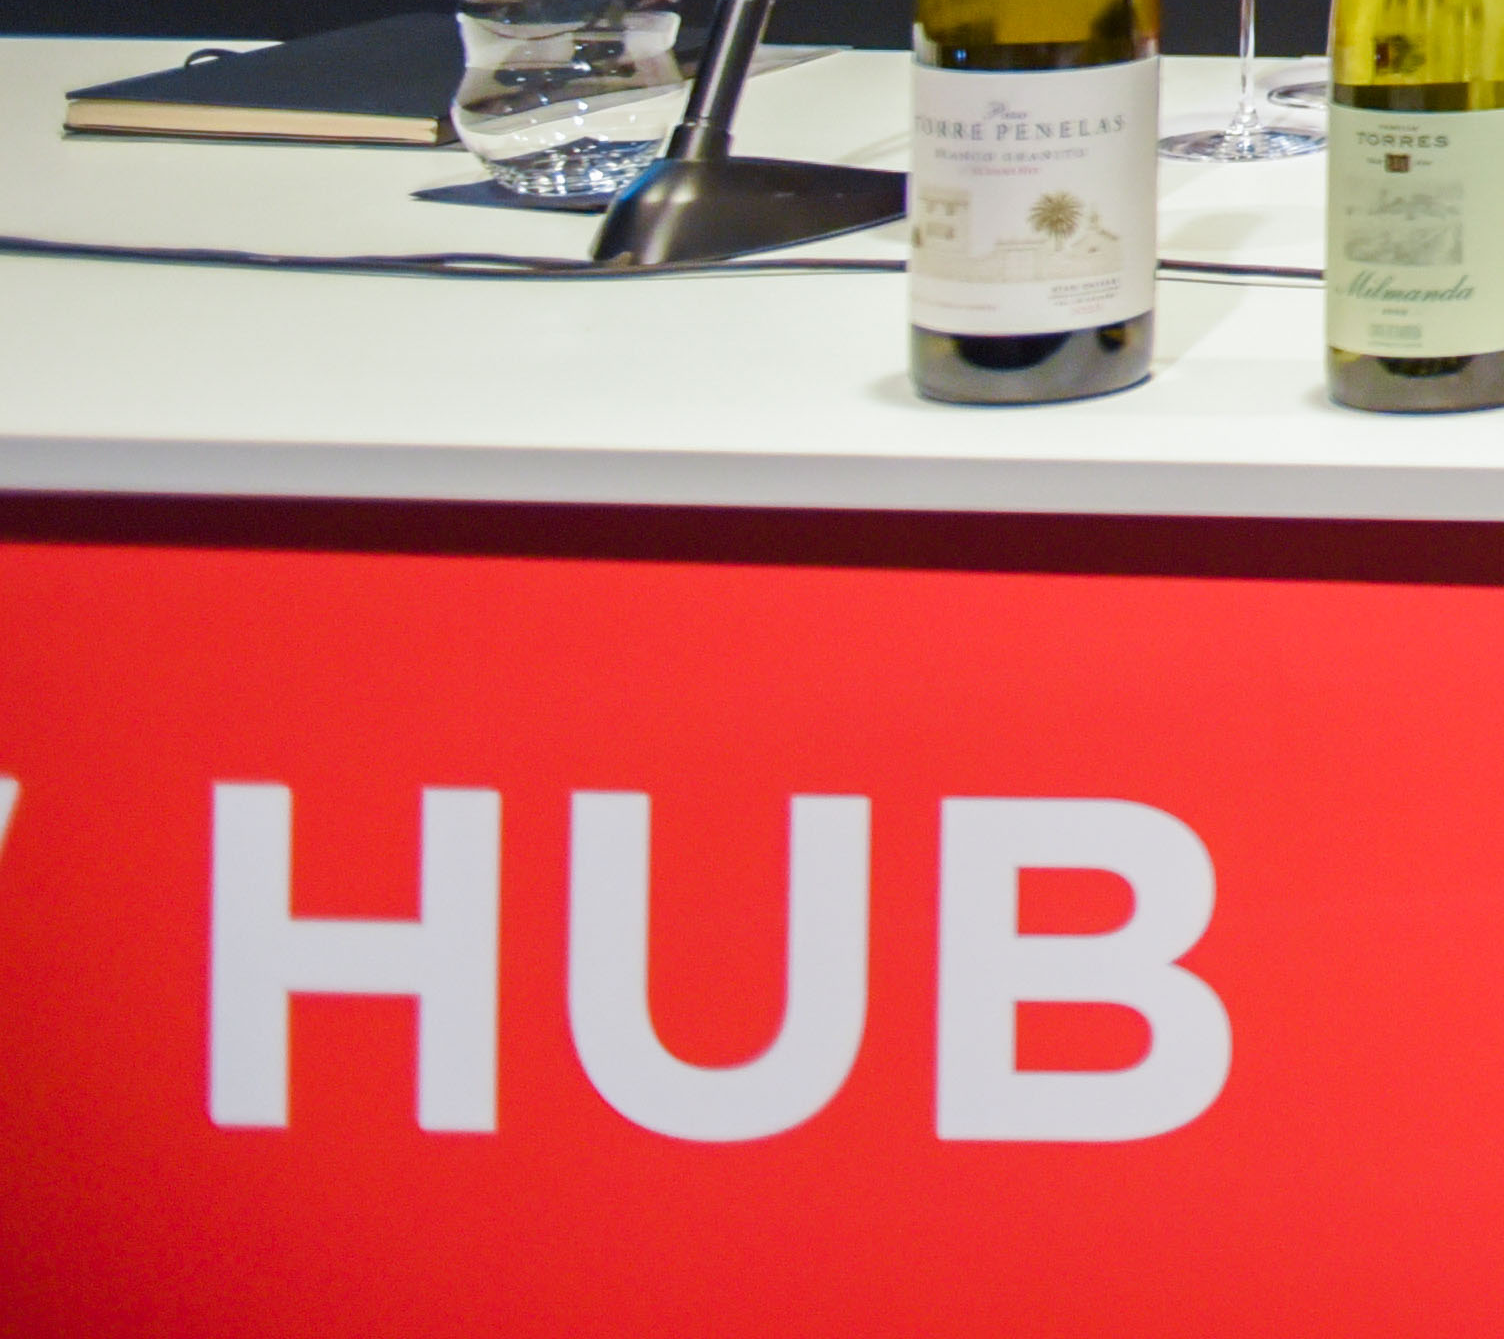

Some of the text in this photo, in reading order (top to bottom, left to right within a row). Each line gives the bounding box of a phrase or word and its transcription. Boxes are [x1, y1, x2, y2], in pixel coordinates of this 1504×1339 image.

[996, 114, 1126, 141] PENELAS
[1355, 131, 1450, 148] TORRES
[1337, 270, 1477, 304] Milmanda
[207, 779, 1235, 1145] HUB
